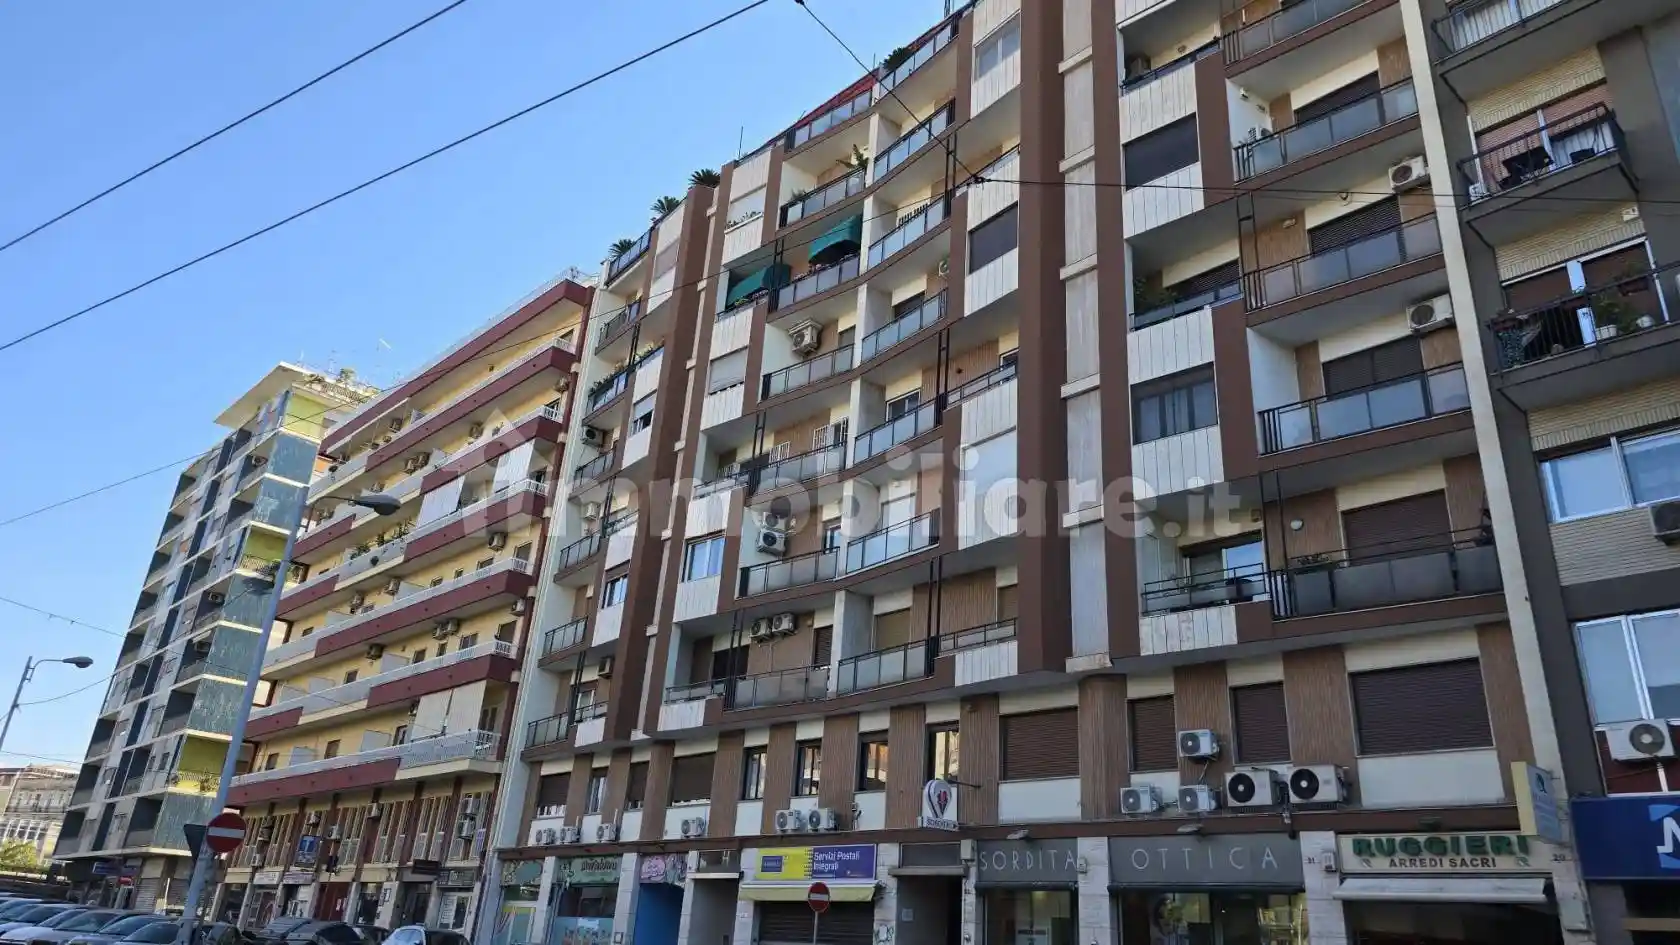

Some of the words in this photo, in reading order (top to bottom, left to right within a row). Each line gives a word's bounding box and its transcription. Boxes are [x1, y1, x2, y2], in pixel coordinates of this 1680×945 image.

[1352, 835, 1530, 857] RUGGIERI
[813, 851, 836, 861] Servizi
[837, 850, 860, 861] Postali
[1131, 847, 1278, 870] OTTICA
[1388, 857, 1443, 868] ARREDI
[1449, 857, 1497, 868] SACRI
